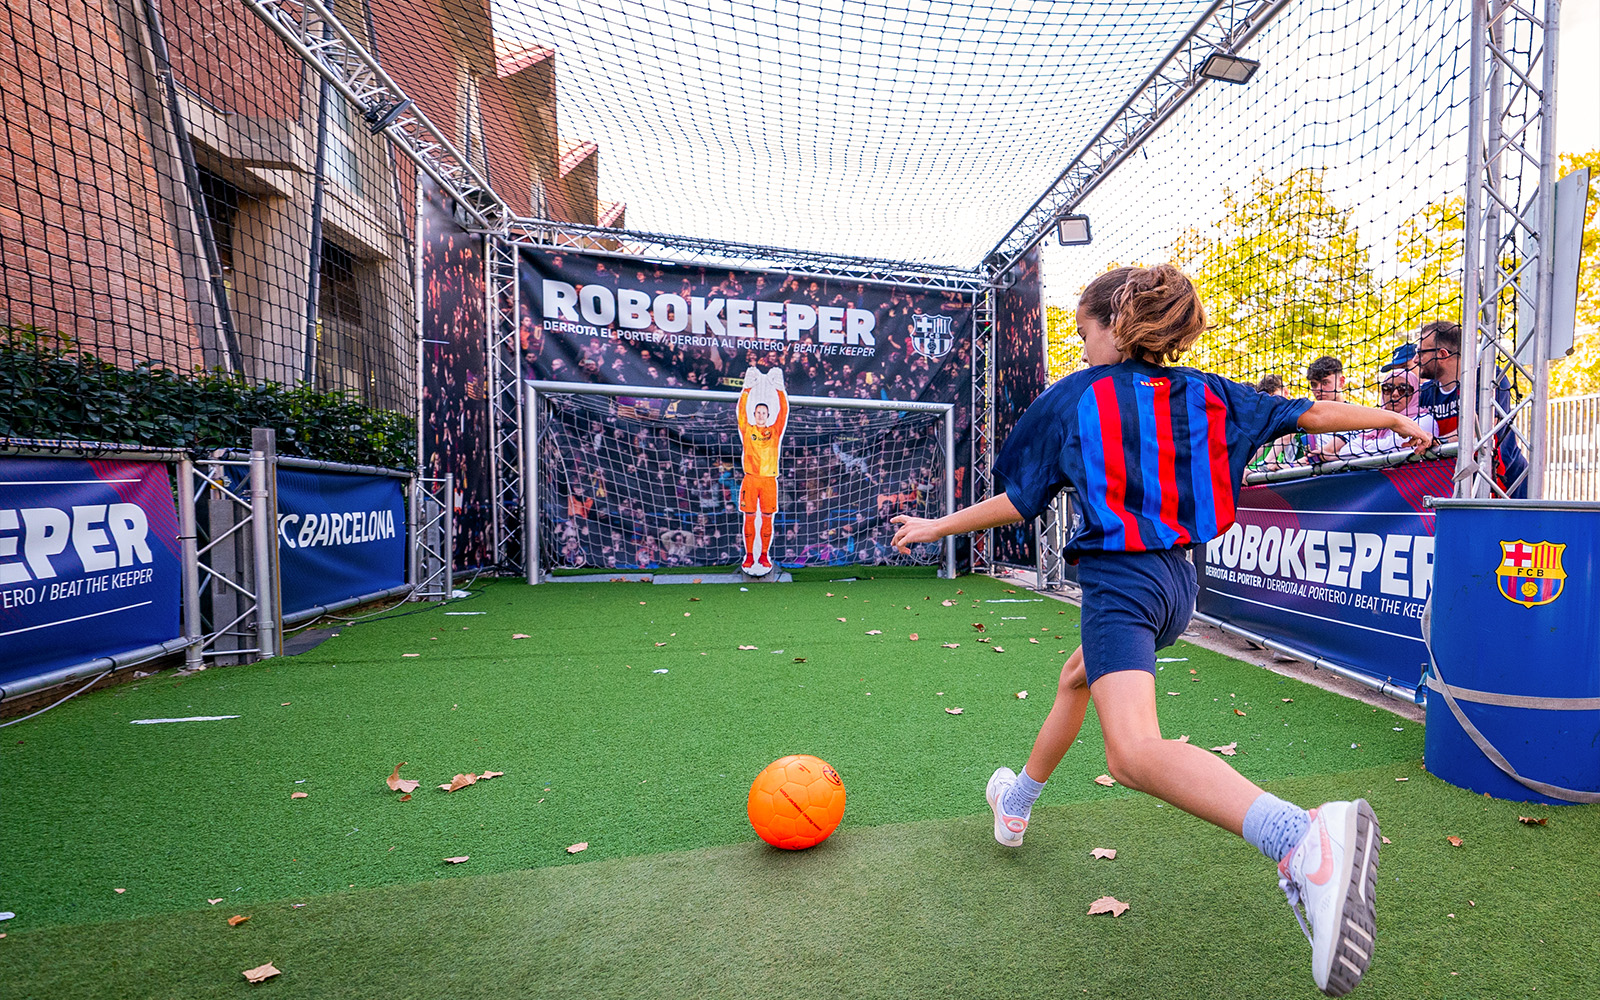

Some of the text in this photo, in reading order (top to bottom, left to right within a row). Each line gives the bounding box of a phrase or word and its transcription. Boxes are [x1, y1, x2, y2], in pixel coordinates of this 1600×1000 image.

[542, 279, 876, 346] ROBOKEEPER
[543, 320, 598, 337] DERROTA
[600, 328, 615, 338] EL
[617, 330, 660, 343] PORTER
[670, 334, 719, 348] DERROTA
[721, 339, 734, 349] AL
[737, 340, 784, 352] PORTERO
[793, 343, 819, 354] BEAT
[819, 345, 837, 355] THE
[838, 346, 876, 357] KEEPER
[298, 509, 396, 548] BARCELONA
[0, 568, 154, 609] ERO / BEAT THE KEEPER
[1205, 565, 1228, 581] DERROTA
[1229, 571, 1237, 583] EL
[1237, 572, 1262, 588] PORTER
[1267, 578, 1298, 595] DERROTA
[1297, 583, 1307, 598] AL
[1308, 586, 1347, 605] PORTERO
[1347, 593, 1353, 606] /
[1354, 594, 1379, 611] BEAT
[1380, 598, 1401, 615] THE
[1517, 568, 1544, 577] FCB
